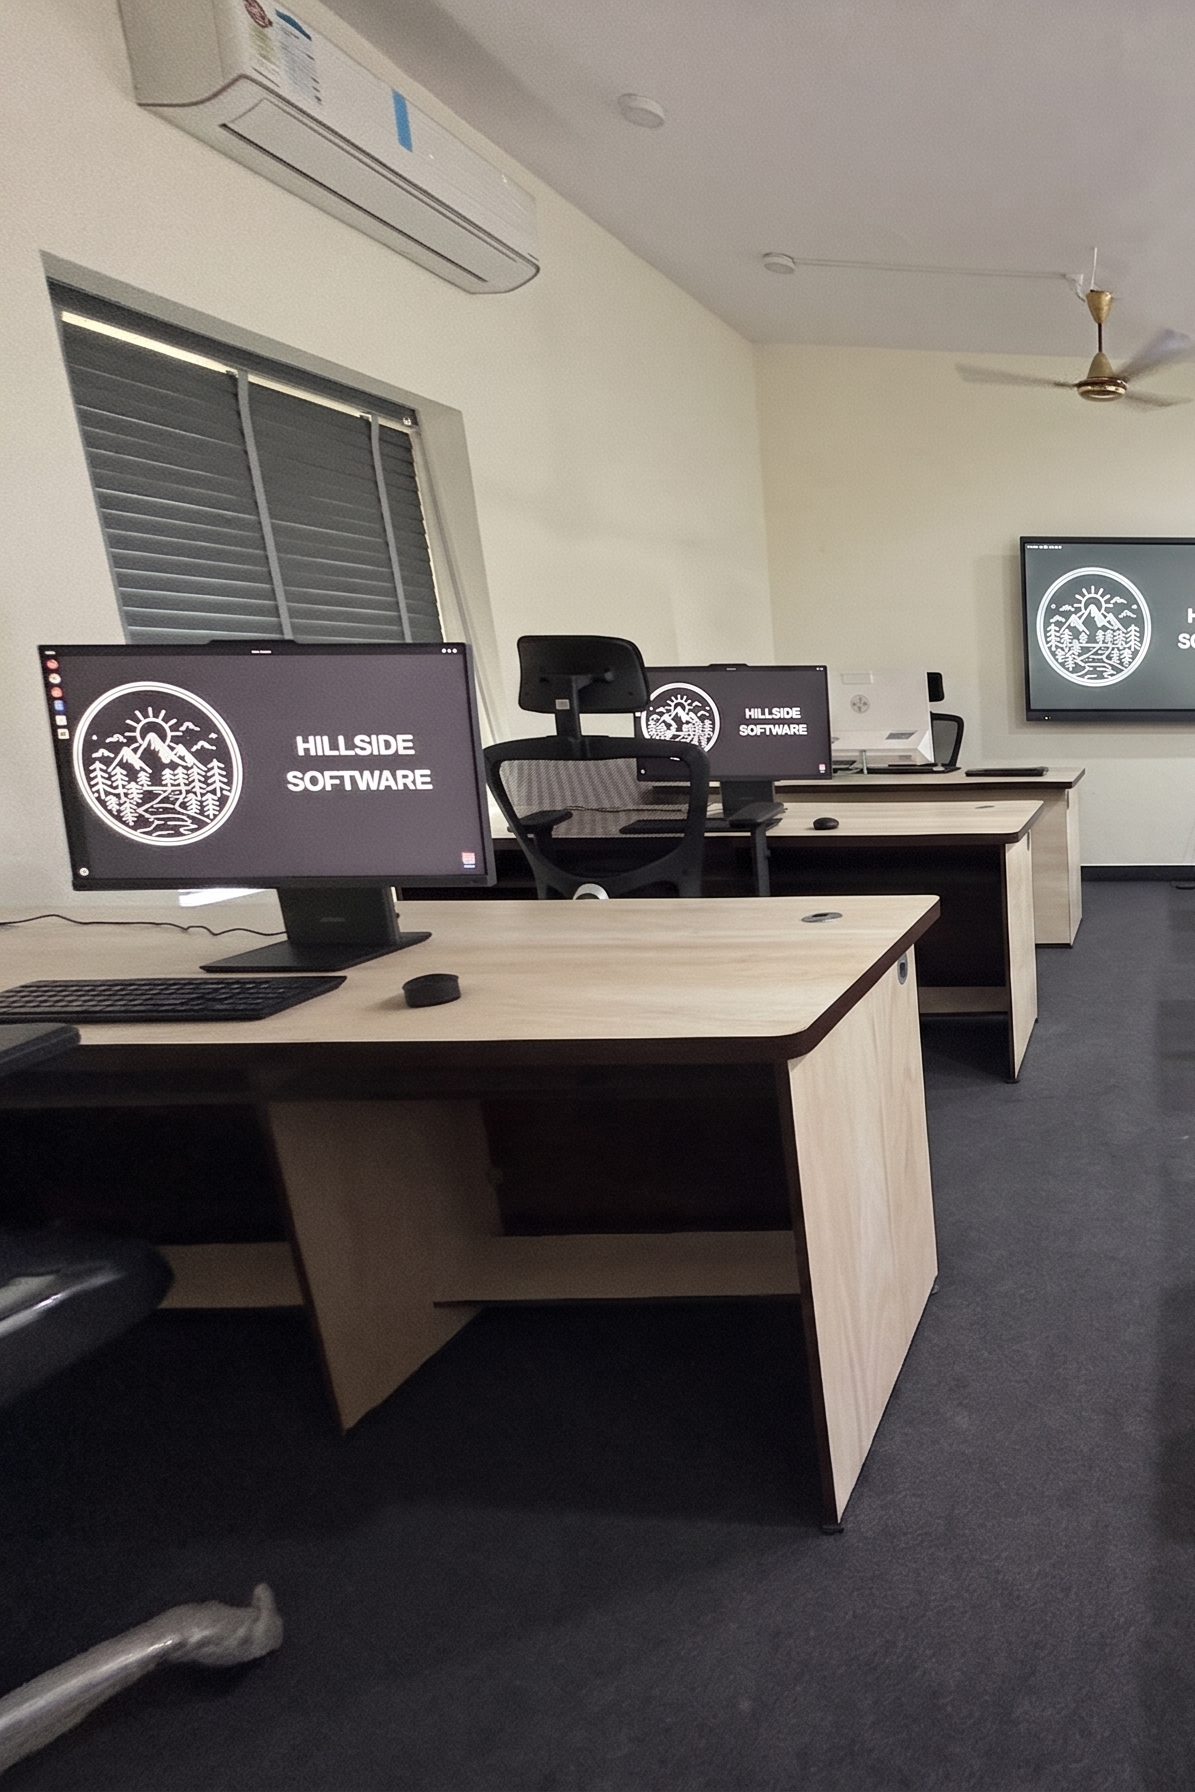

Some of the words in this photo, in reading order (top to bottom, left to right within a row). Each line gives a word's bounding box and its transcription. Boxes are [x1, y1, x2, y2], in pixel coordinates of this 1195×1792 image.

[745, 707, 801, 719] HILLSIDE
[739, 724, 808, 736] SOFTWARE
[296, 734, 415, 756] HILLSIDE
[286, 769, 433, 792] SOFTWARE
